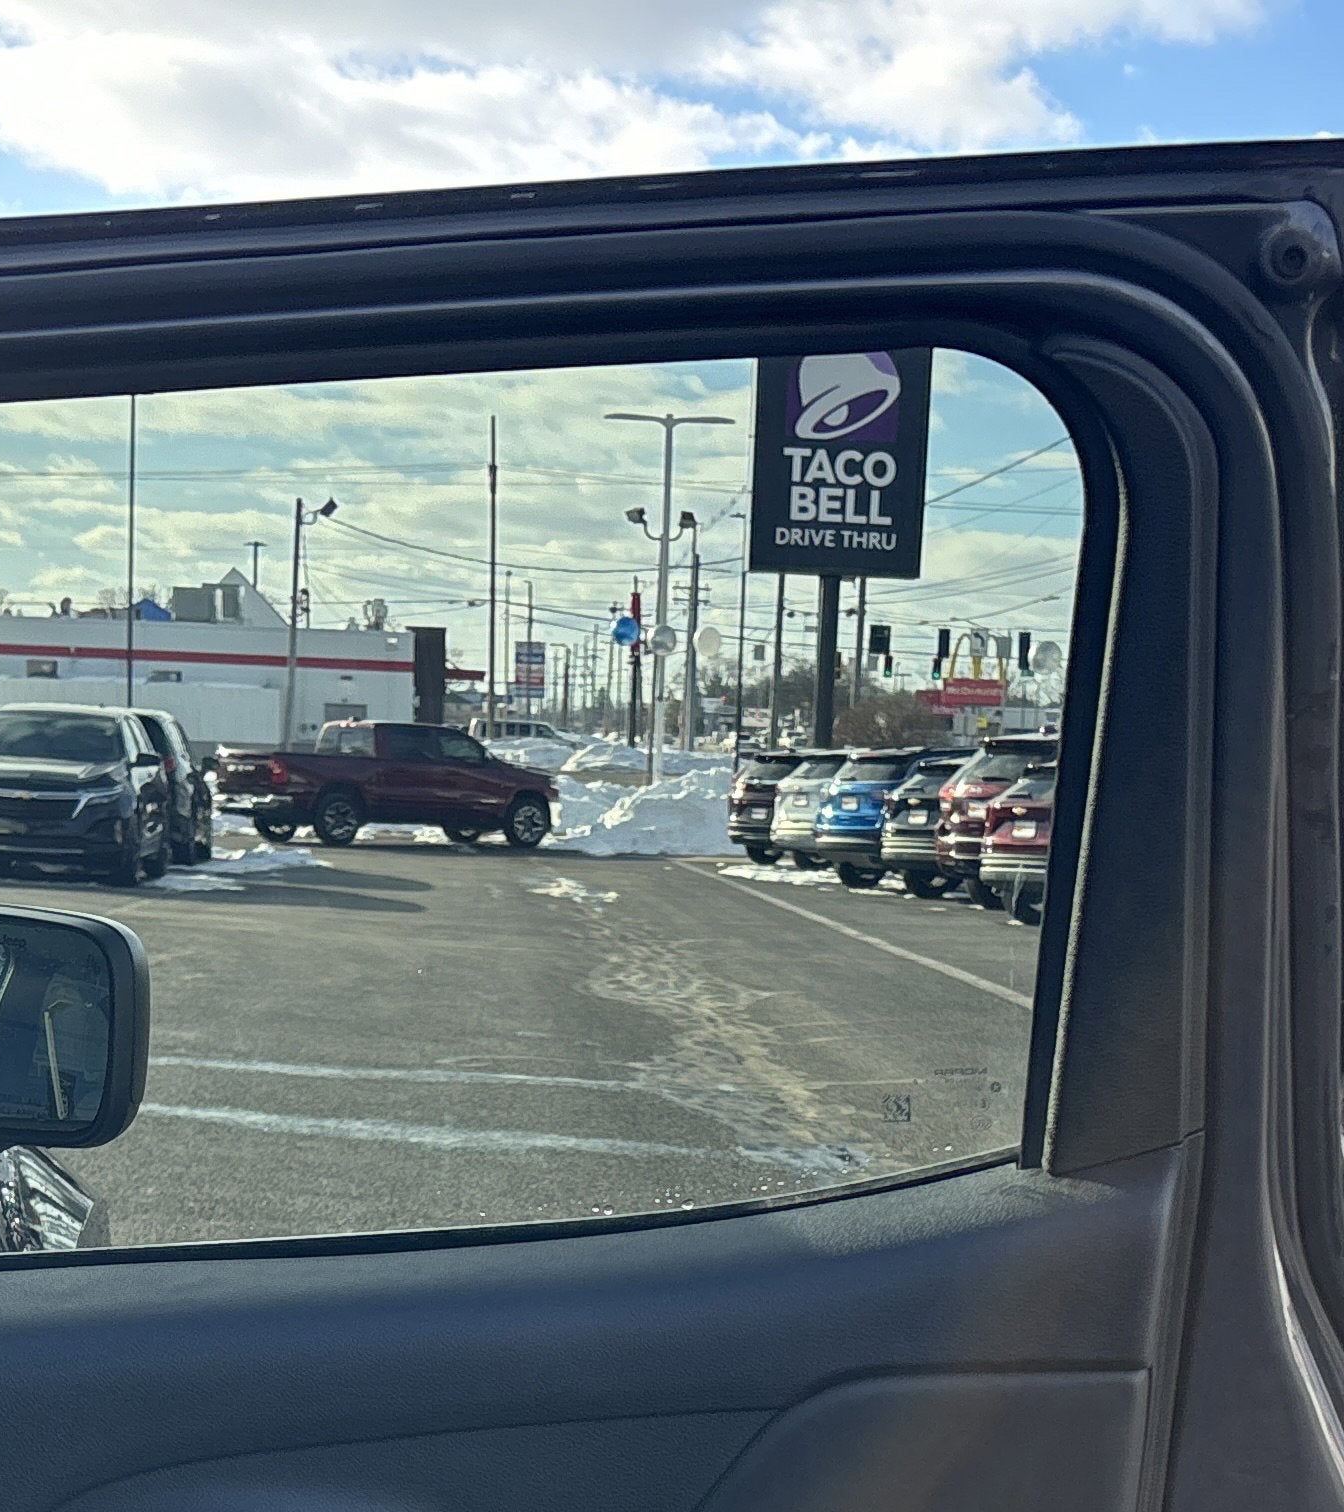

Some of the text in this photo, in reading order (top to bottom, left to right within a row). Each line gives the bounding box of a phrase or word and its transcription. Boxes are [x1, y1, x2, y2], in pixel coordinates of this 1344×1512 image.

[782, 447, 897, 488] TACO
[789, 485, 893, 526] BELL
[774, 527, 898, 551] DRIVE THRU
